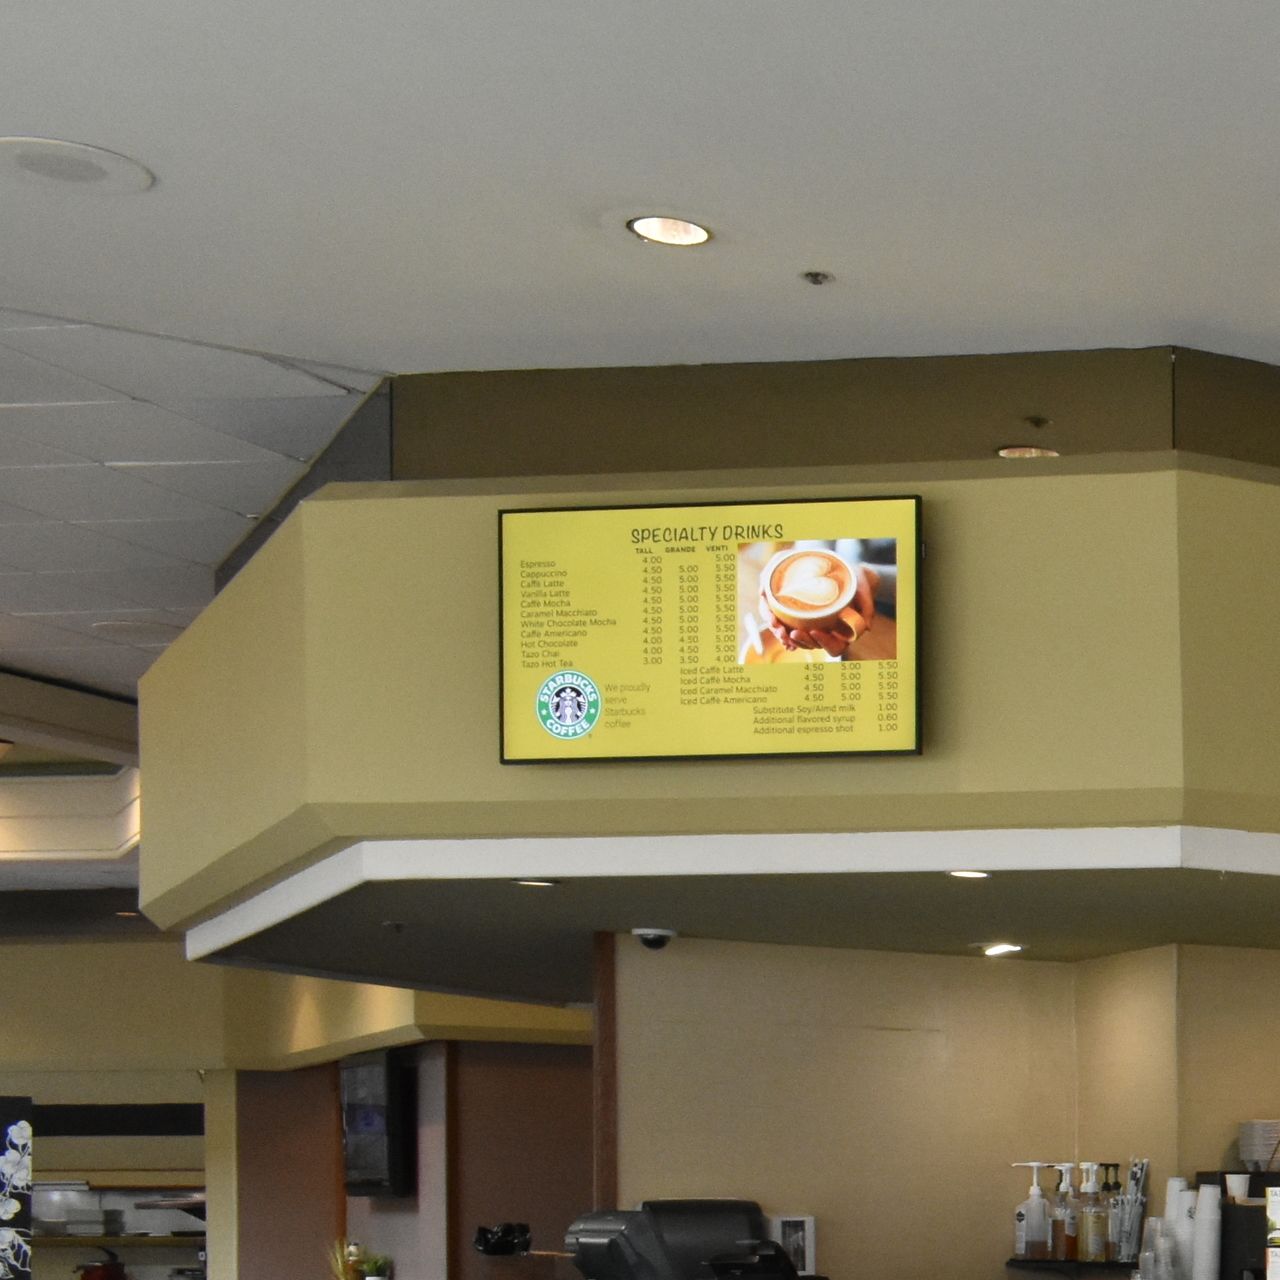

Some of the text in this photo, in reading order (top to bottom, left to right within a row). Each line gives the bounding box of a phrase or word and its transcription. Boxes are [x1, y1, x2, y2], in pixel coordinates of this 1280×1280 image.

[631, 525, 783, 544] SPECIALTY DRINKS
[520, 560, 556, 569] Espresso
[642, 556, 662, 564] 4.00
[520, 570, 567, 579] Cappuccino
[642, 566, 662, 574] 4.50
[544, 579, 564, 587] Latte
[642, 576, 662, 584] 4.50
[521, 590, 547, 598] Vanilla
[642, 586, 662, 594] 4.50
[544, 599, 571, 608] Mocha
[521, 610, 554, 618] Caramel
[556, 609, 597, 617] Macchiato
[642, 606, 662, 614] 4.50
[679, 605, 698, 613] 5.00
[521, 620, 544, 628] White
[546, 619, 587, 627] Chocolate
[590, 618, 616, 626] Mocha
[642, 616, 662, 624] 4.50
[544, 629, 587, 637] Americano
[642, 626, 662, 634] 4.50
[679, 625, 698, 633] 5.00
[716, 624, 735, 632] 5.50
[521, 640, 535, 648] Hot
[538, 639, 578, 648] Chocolate
[716, 634, 735, 642] 5.00
[542, 650, 559, 658] Chai
[541, 660, 556, 668] Hot
[680, 667, 697, 675] Iced
[723, 666, 744, 674] Latte
[723, 676, 751, 684] Mocha
[539, 673, 598, 703] STARBUCKS
[700, 686, 733, 694] Caramel
[735, 685, 777, 693] Macchiato
[723, 696, 767, 704] Americano
[753, 706, 794, 714] Substitute
[839, 704, 856, 712] milk
[753, 716, 794, 724] Additional
[797, 715, 831, 723] flavored
[833, 716, 855, 724] syrup
[546, 719, 590, 736] COFFEE
[798, 727, 833, 735] espresso
